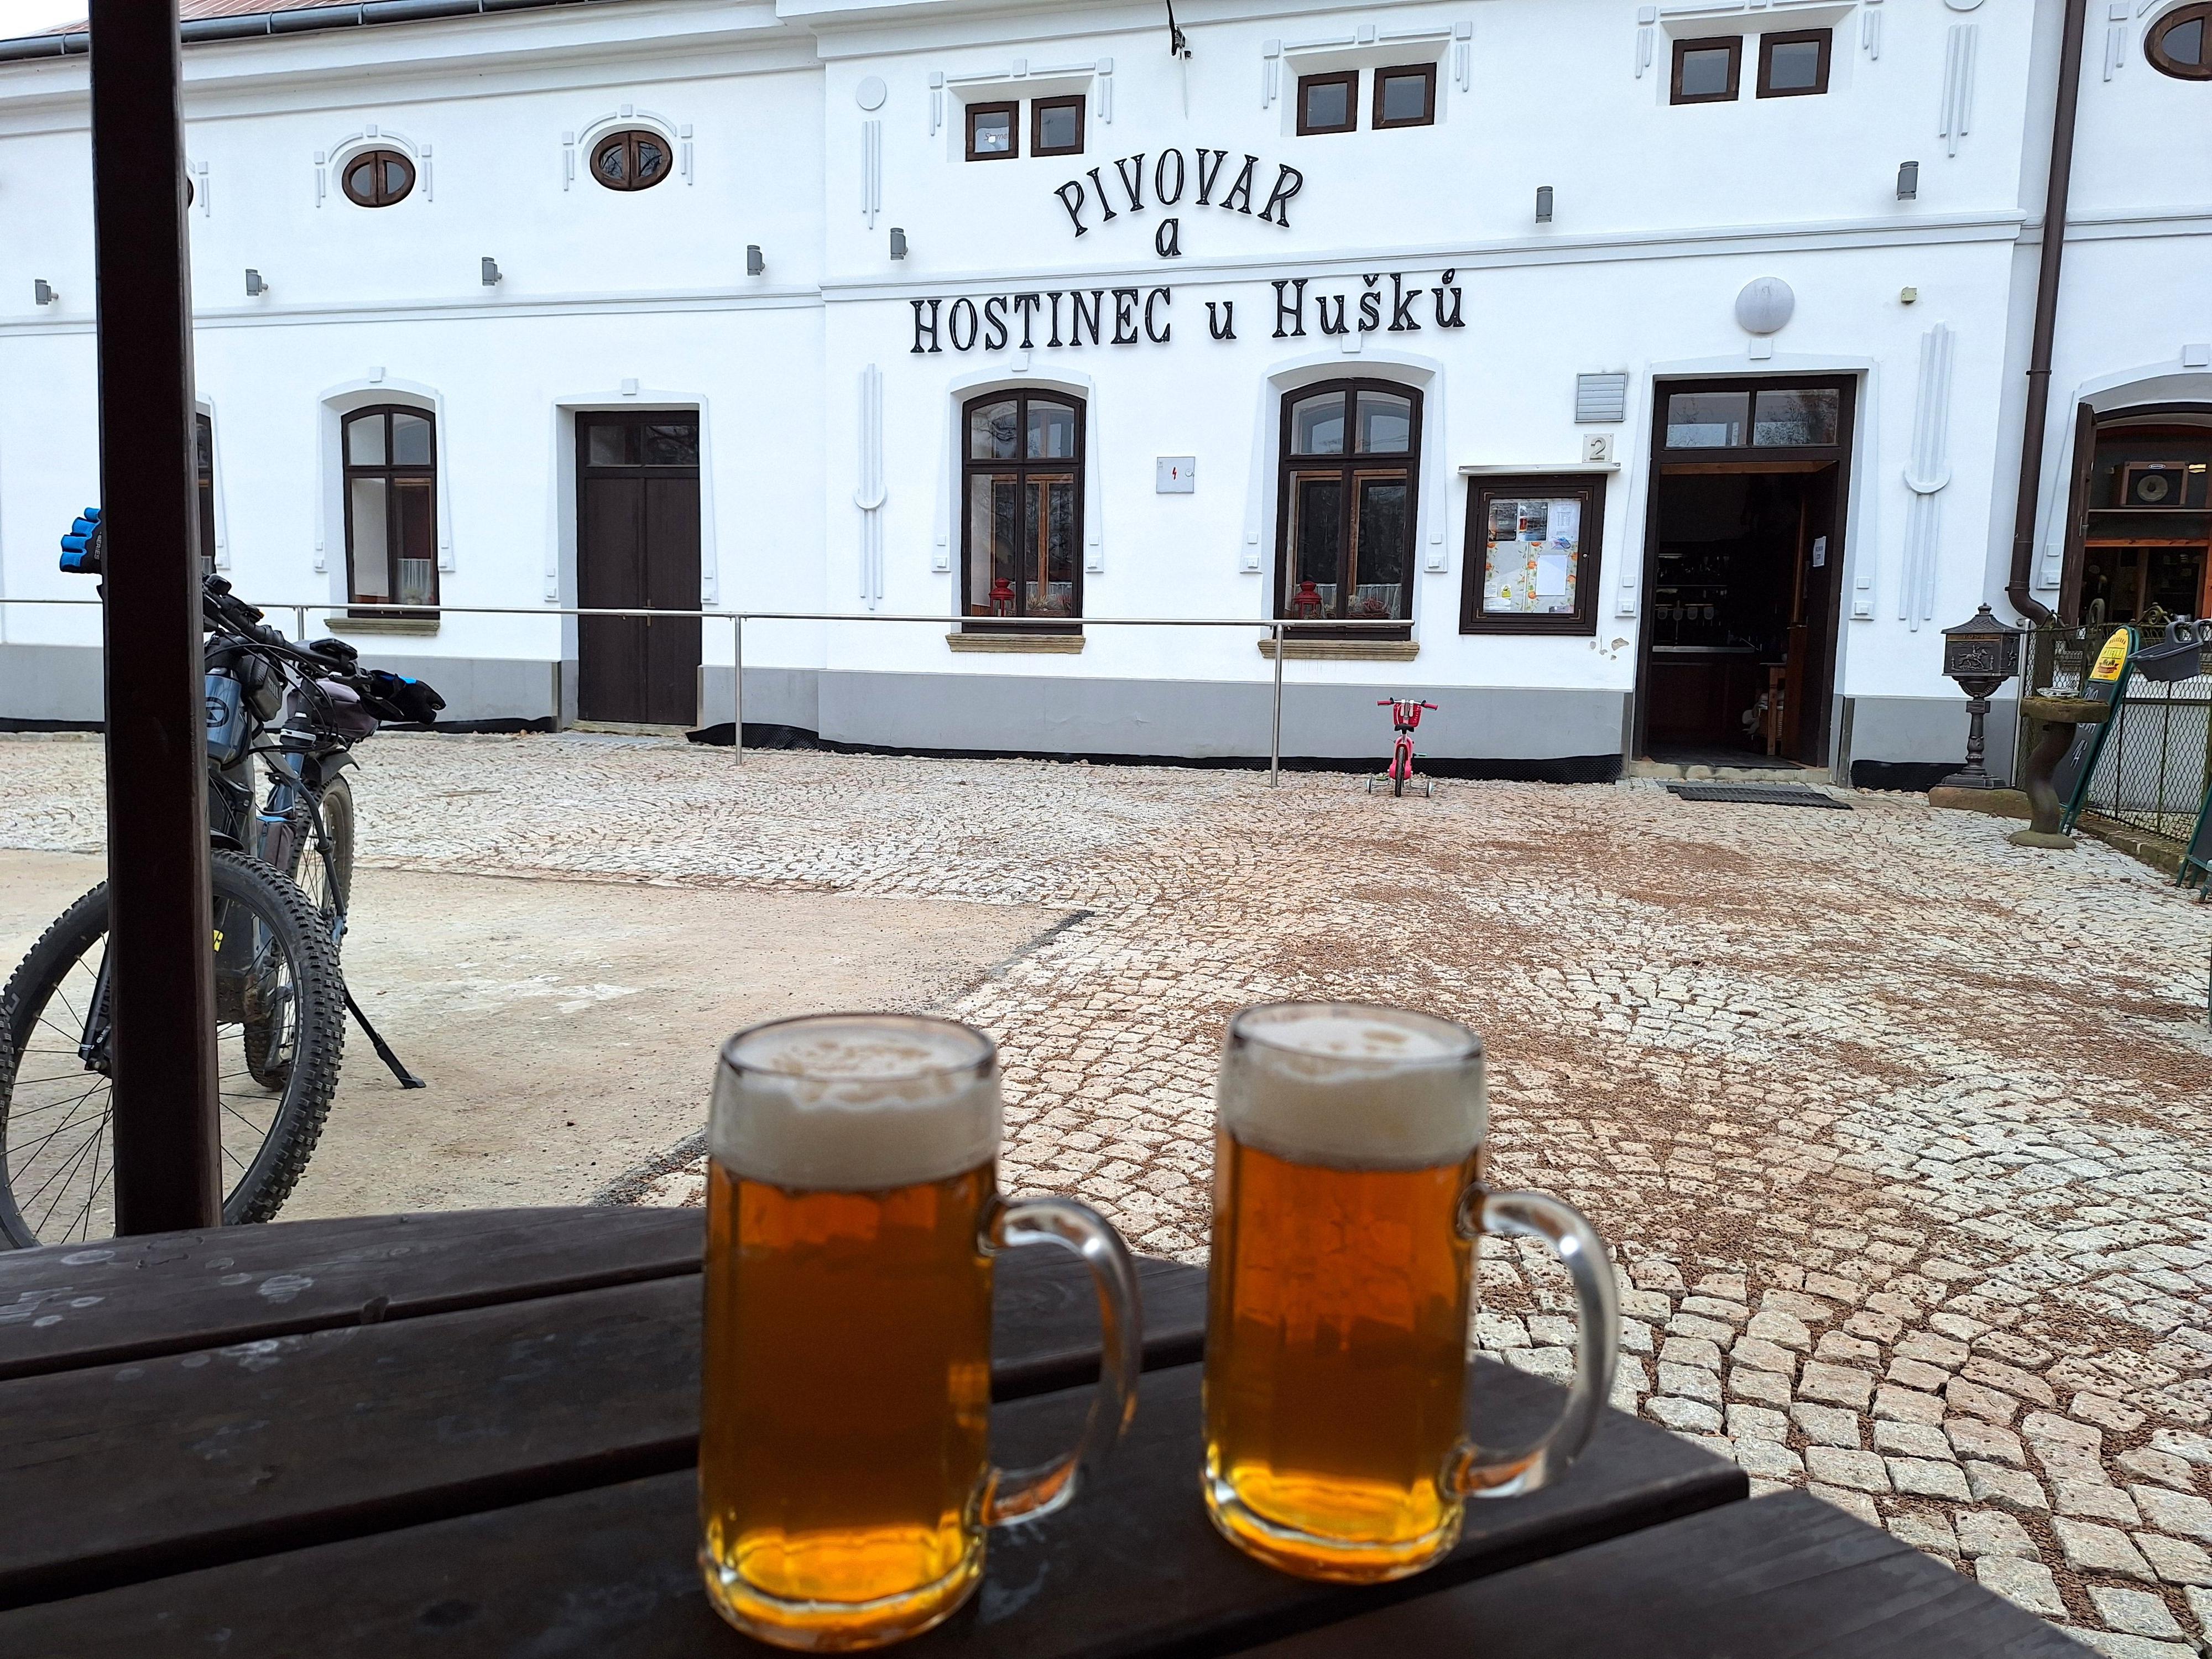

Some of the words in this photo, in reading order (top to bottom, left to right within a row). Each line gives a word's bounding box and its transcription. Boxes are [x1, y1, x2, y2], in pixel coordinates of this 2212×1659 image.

[1053, 148, 1303, 238] PIVOVAR
[1155, 218, 1182, 257] a
[910, 286, 1171, 353] HOSTINEC
[1204, 301, 1237, 340] u
[1271, 268, 1466, 338] Hušků
[1589, 437, 1606, 461] 2
